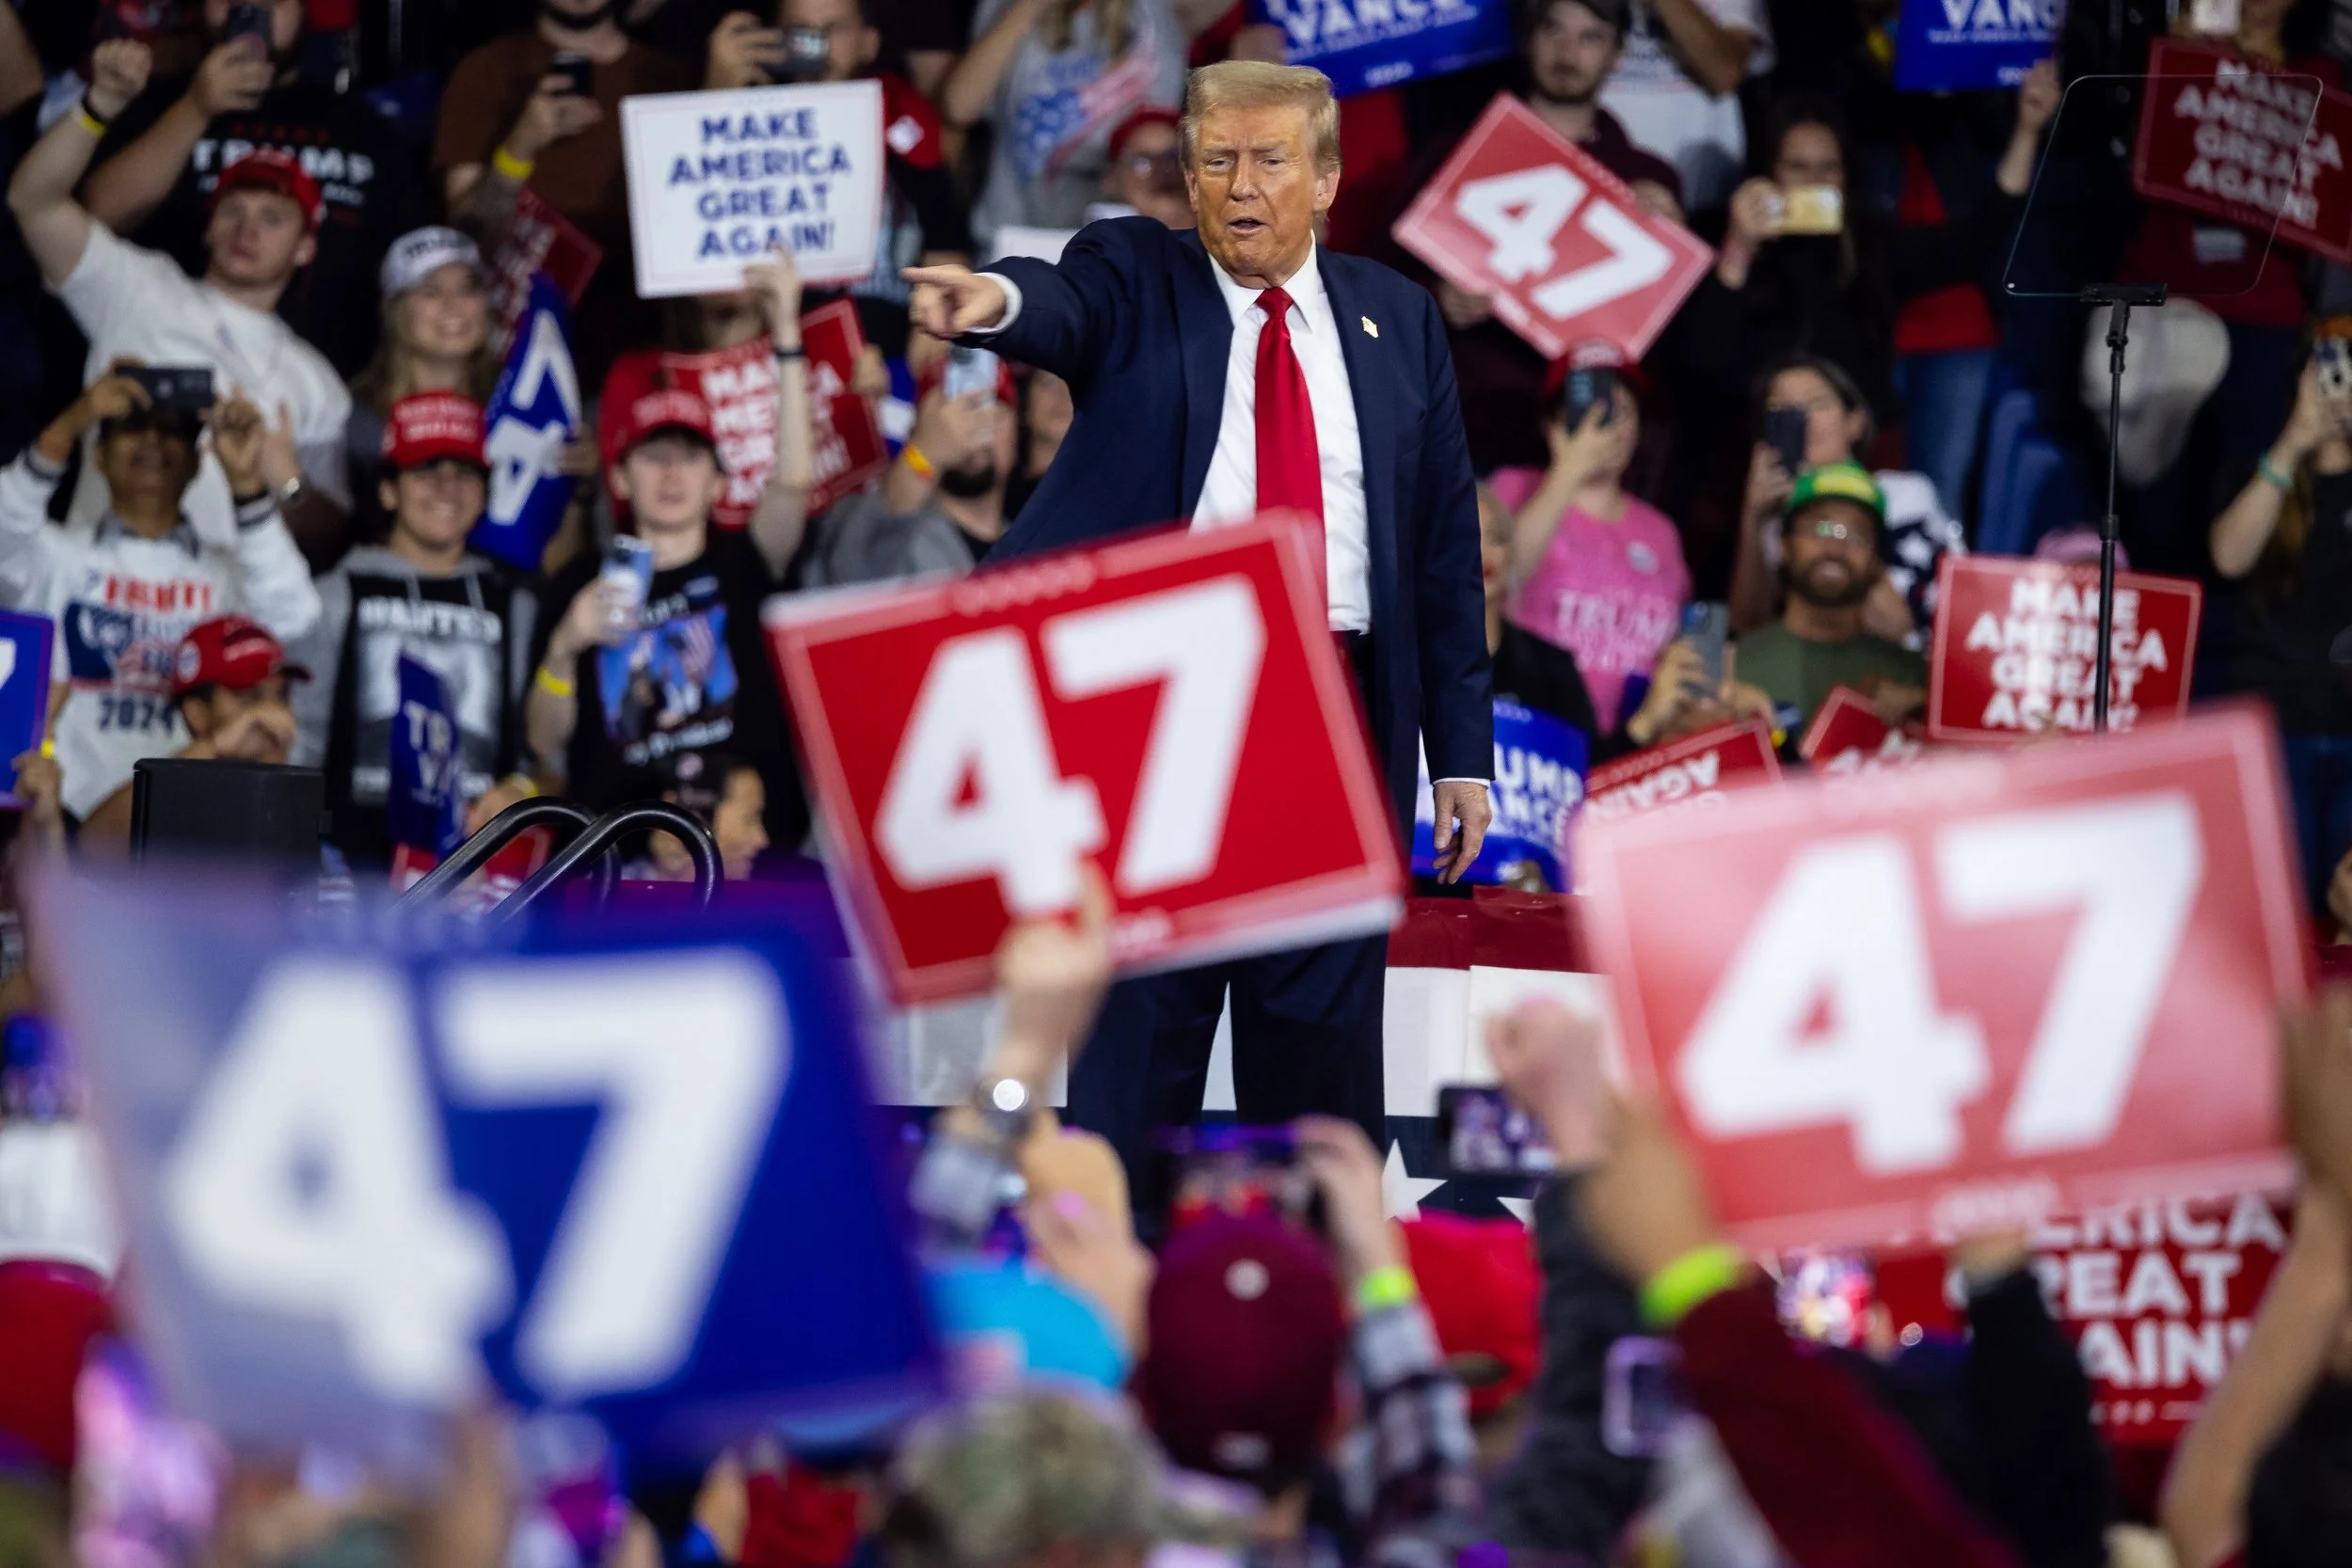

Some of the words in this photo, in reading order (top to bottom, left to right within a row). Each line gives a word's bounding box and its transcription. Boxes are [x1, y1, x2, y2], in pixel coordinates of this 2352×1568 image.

[700, 106, 817, 145] MAKE
[666, 144, 852, 187] AMERICA
[695, 182, 829, 221] GREAT
[696, 220, 835, 262] AGAIN!
[1455, 162, 1674, 320] 47
[877, 576, 1266, 914] 47
[1494, 743, 1584, 805] UMP
[1675, 792, 2209, 1178] 47
[162, 945, 795, 1402] 47
